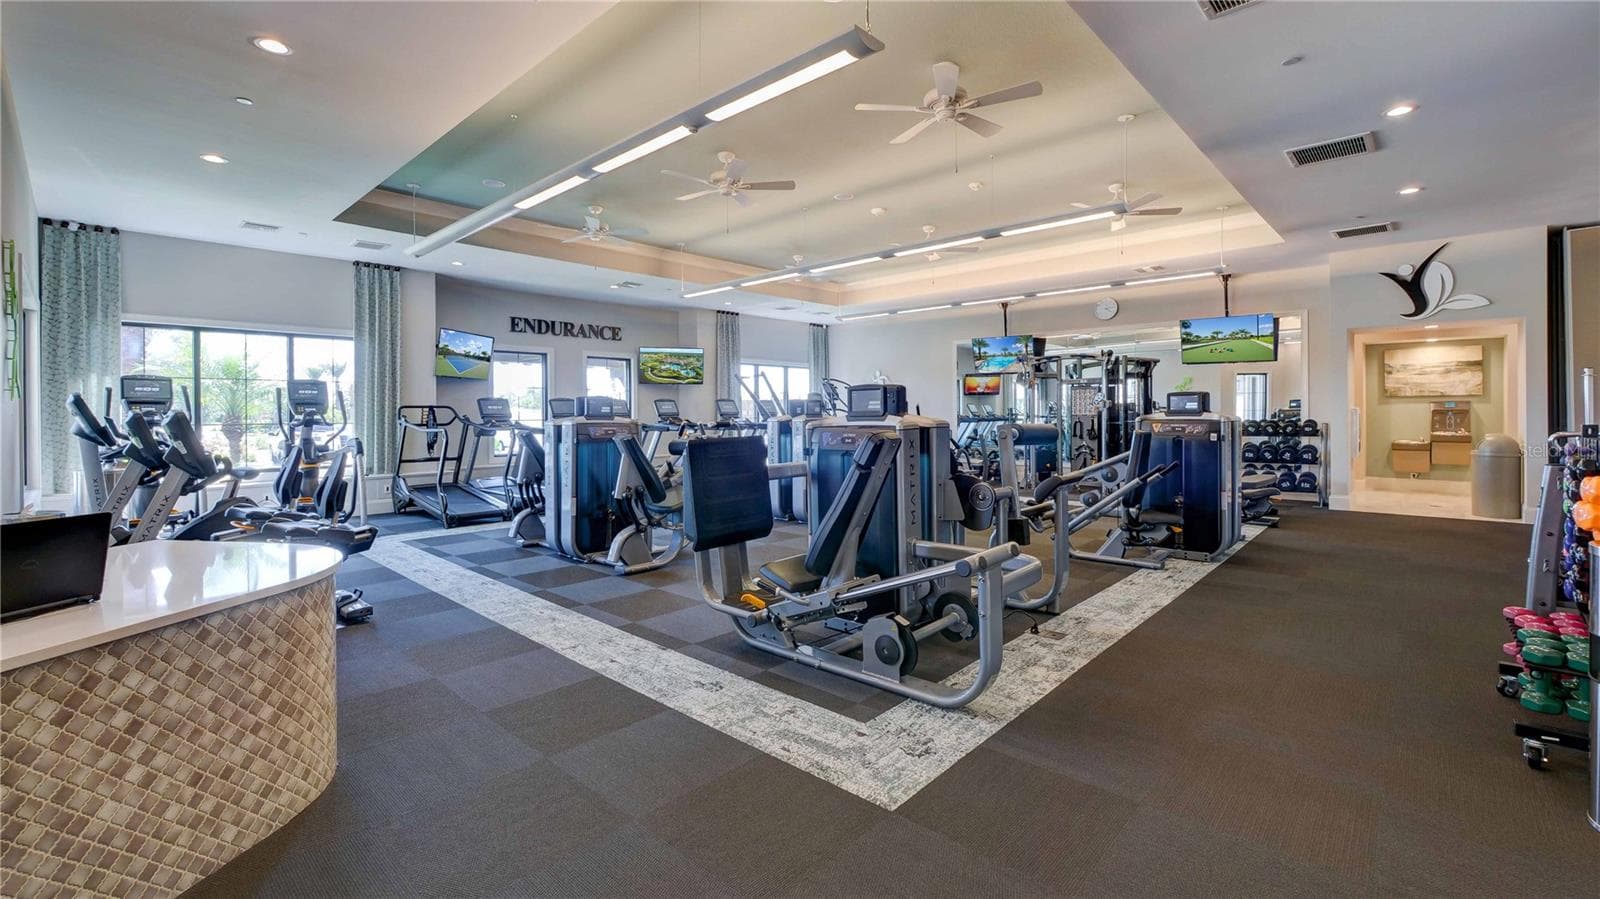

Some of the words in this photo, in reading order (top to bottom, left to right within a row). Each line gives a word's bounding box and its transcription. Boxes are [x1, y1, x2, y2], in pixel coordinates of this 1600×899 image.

[509, 316, 622, 341] ENDURANCE
[92, 478, 103, 512] ATRIX
[909, 439, 917, 526] MATRIX
